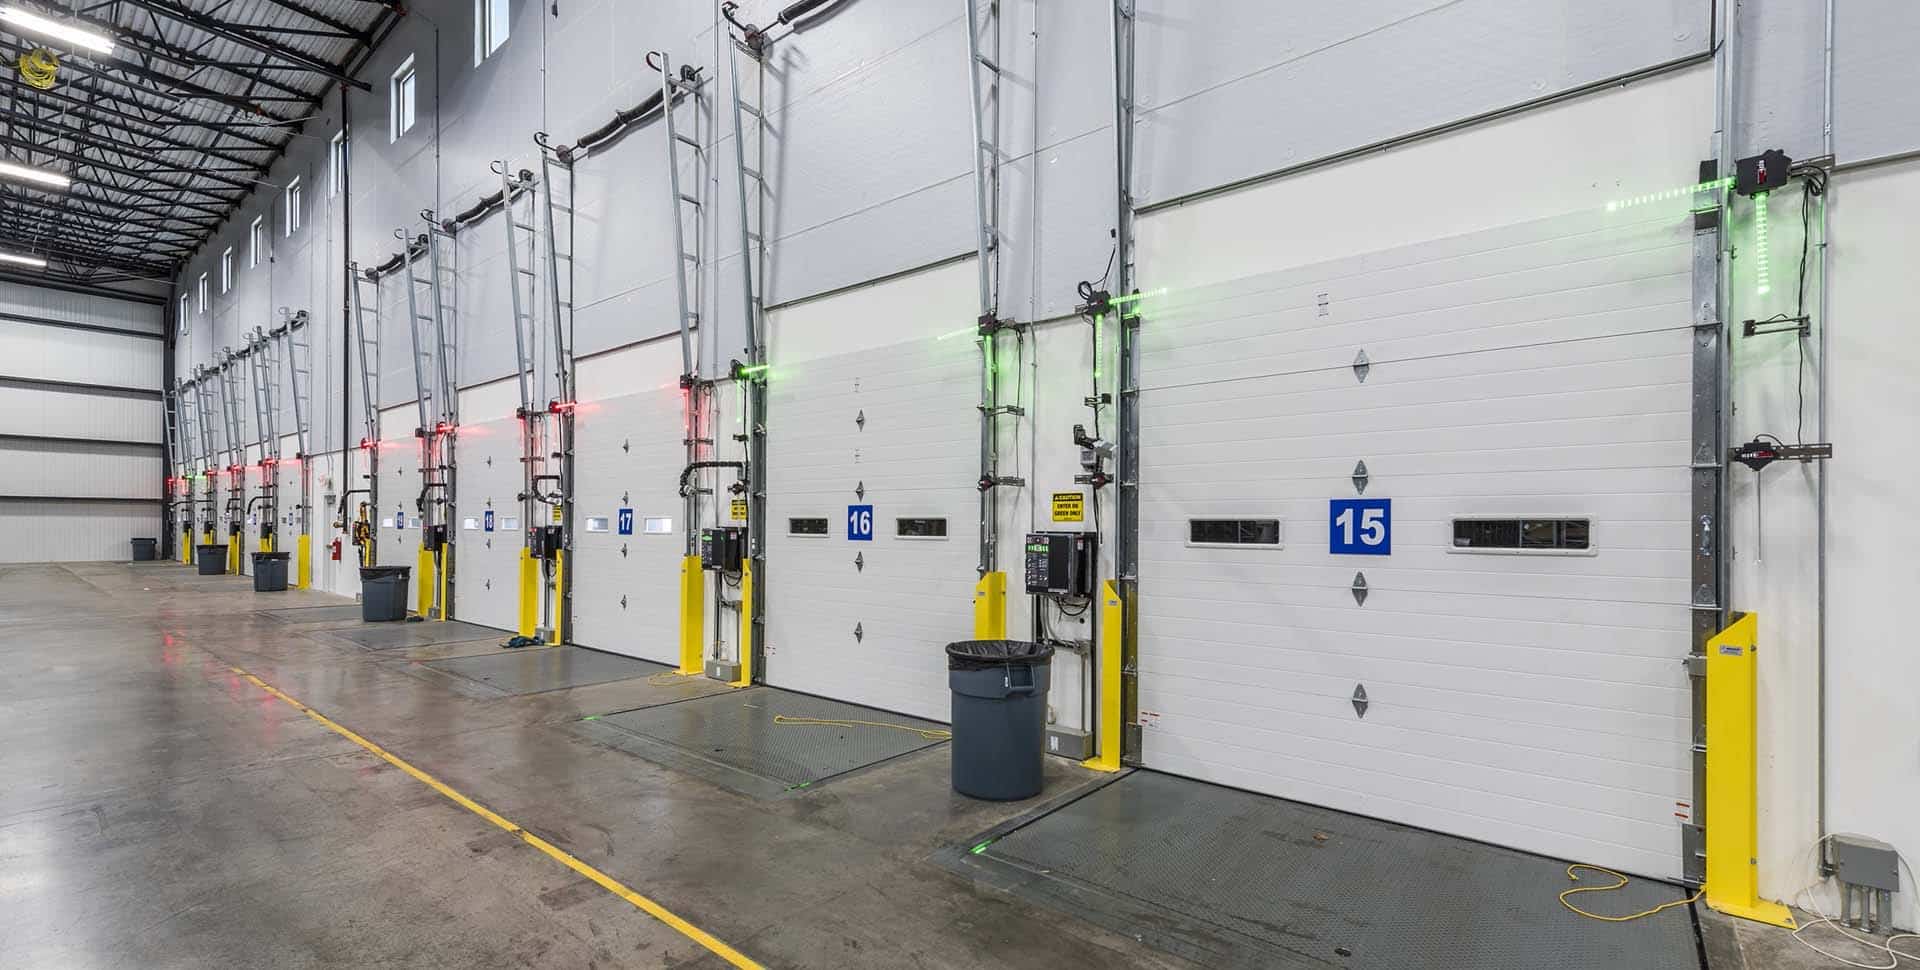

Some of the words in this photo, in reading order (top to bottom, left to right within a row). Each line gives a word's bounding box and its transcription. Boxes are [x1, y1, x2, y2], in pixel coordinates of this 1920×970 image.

[620, 512, 631, 530] 17
[850, 511, 870, 535] 16
[1336, 508, 1385, 545] 15
